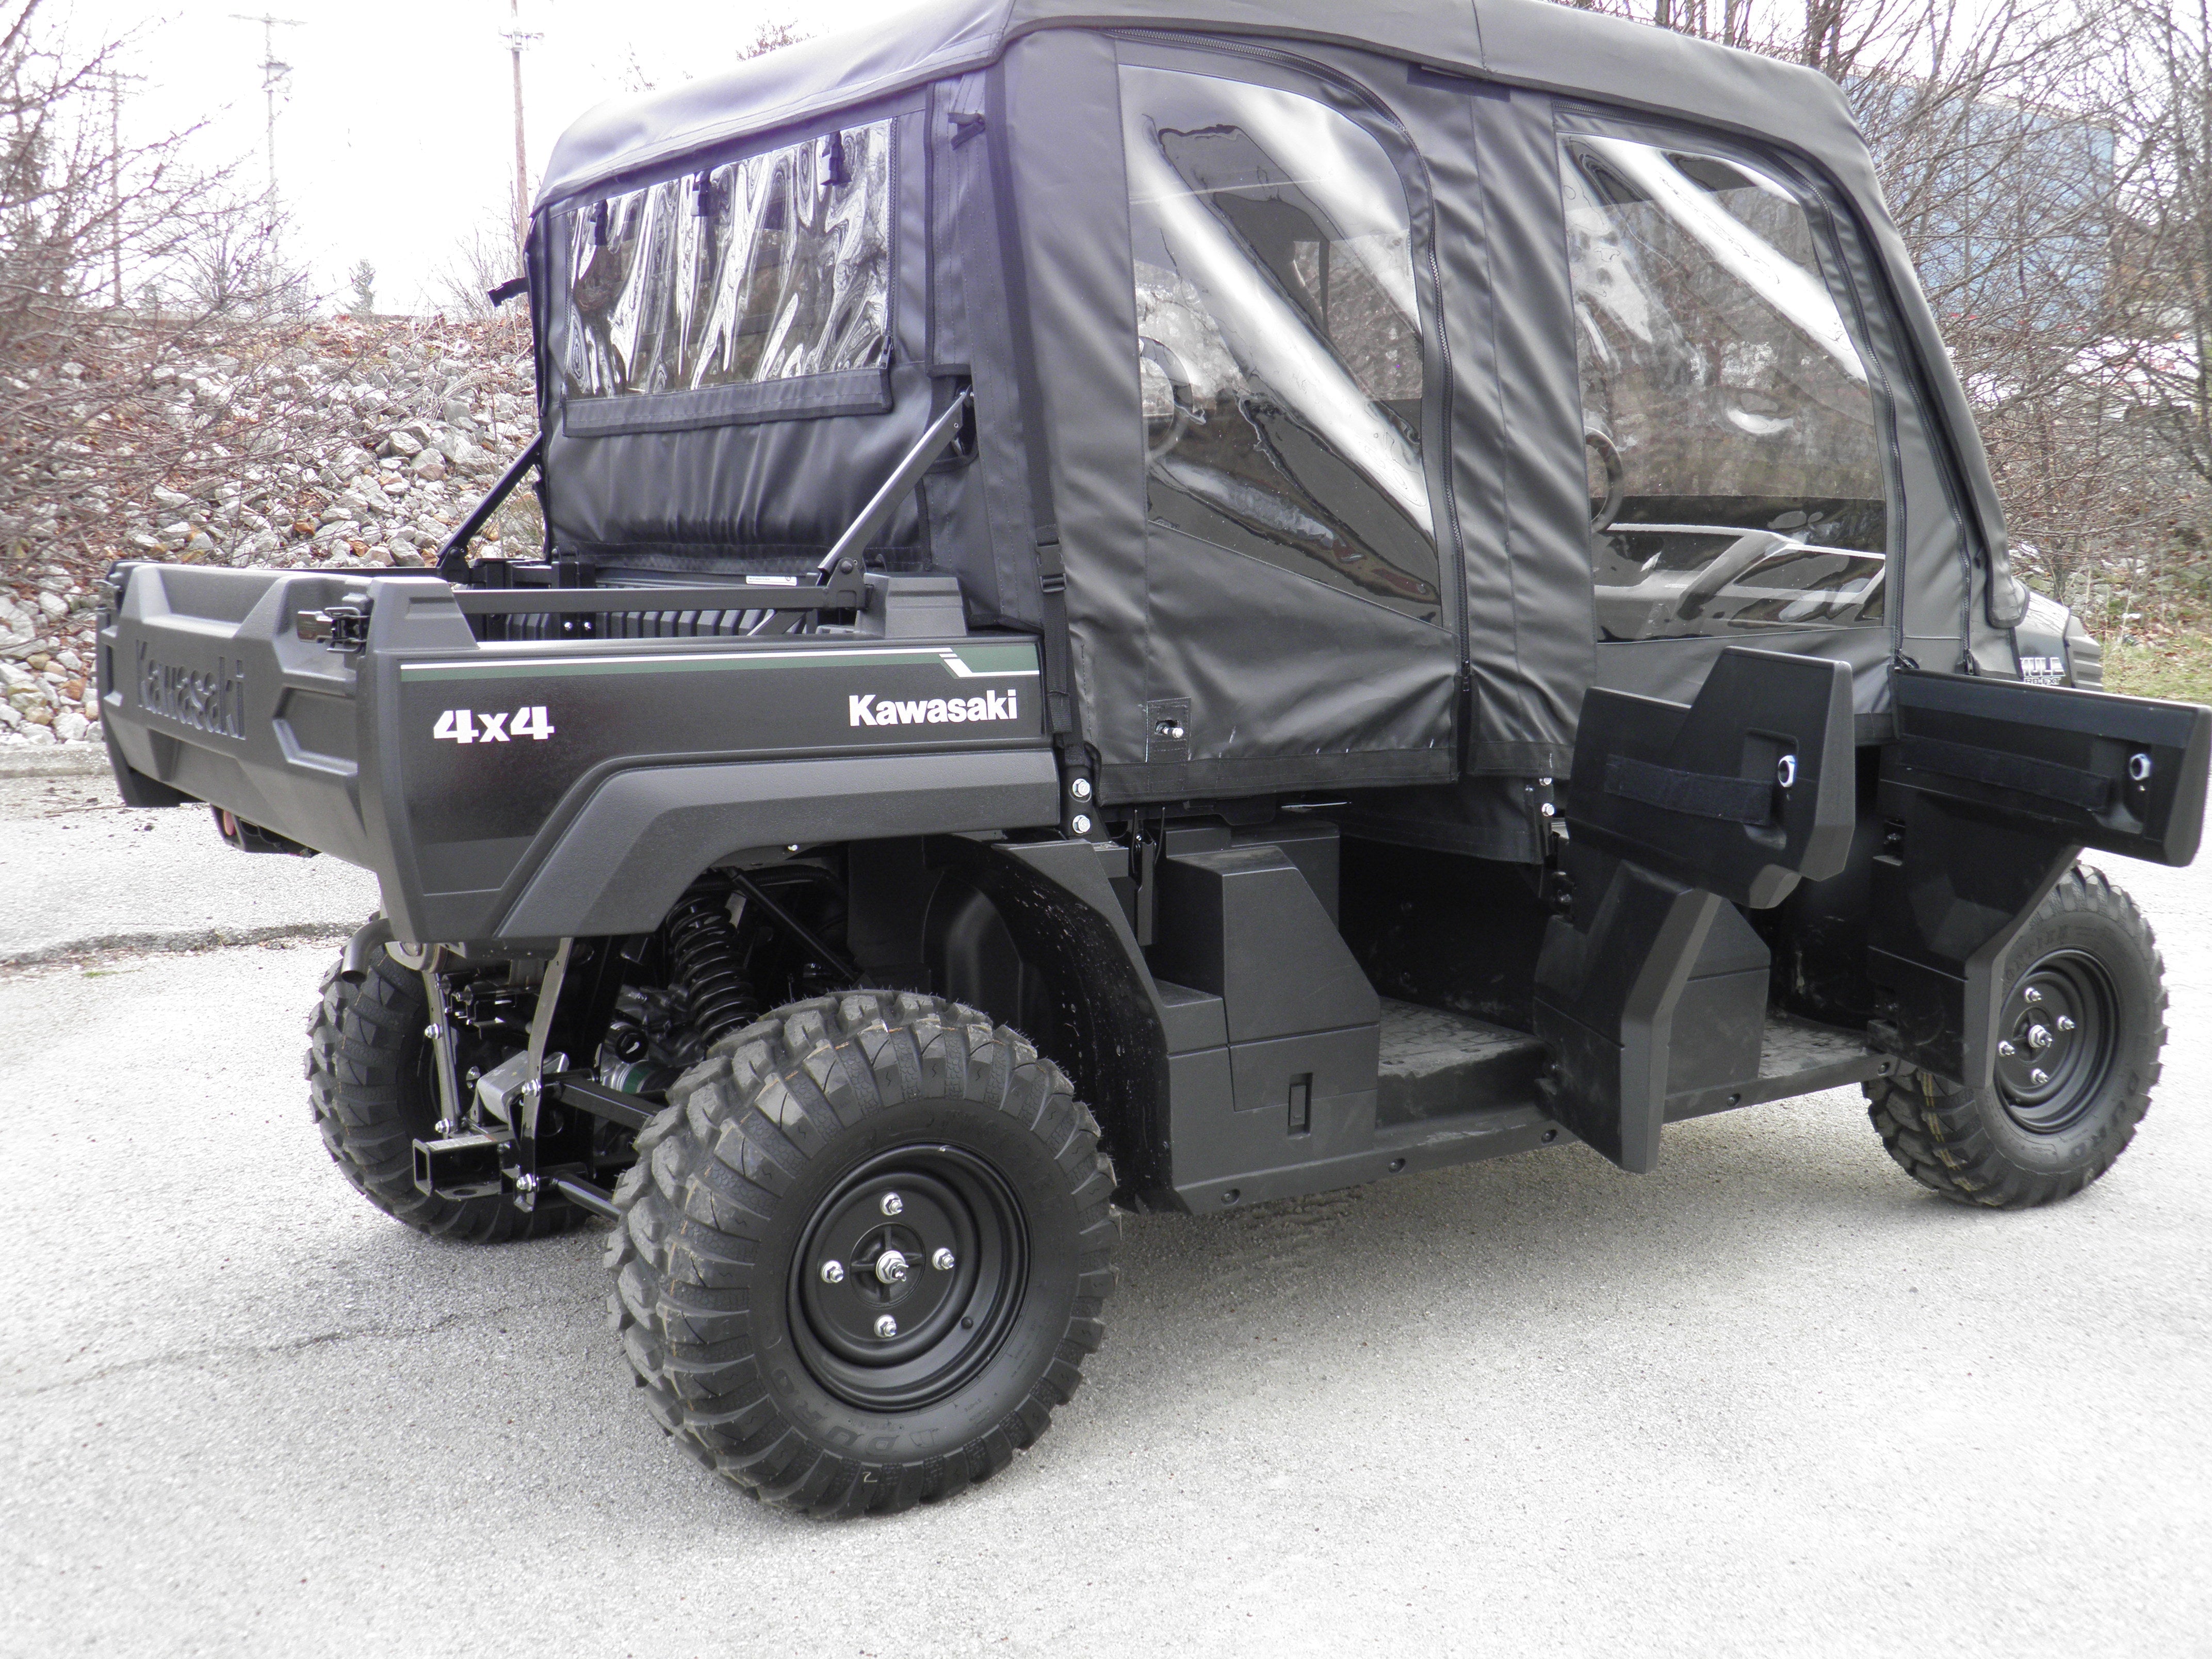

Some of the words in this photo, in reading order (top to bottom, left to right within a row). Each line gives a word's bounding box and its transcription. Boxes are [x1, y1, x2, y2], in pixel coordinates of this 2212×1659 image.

[136, 639, 246, 740] Kawasaki
[849, 689, 1017, 726] Kawasaki
[433, 706, 555, 743] 4x4
